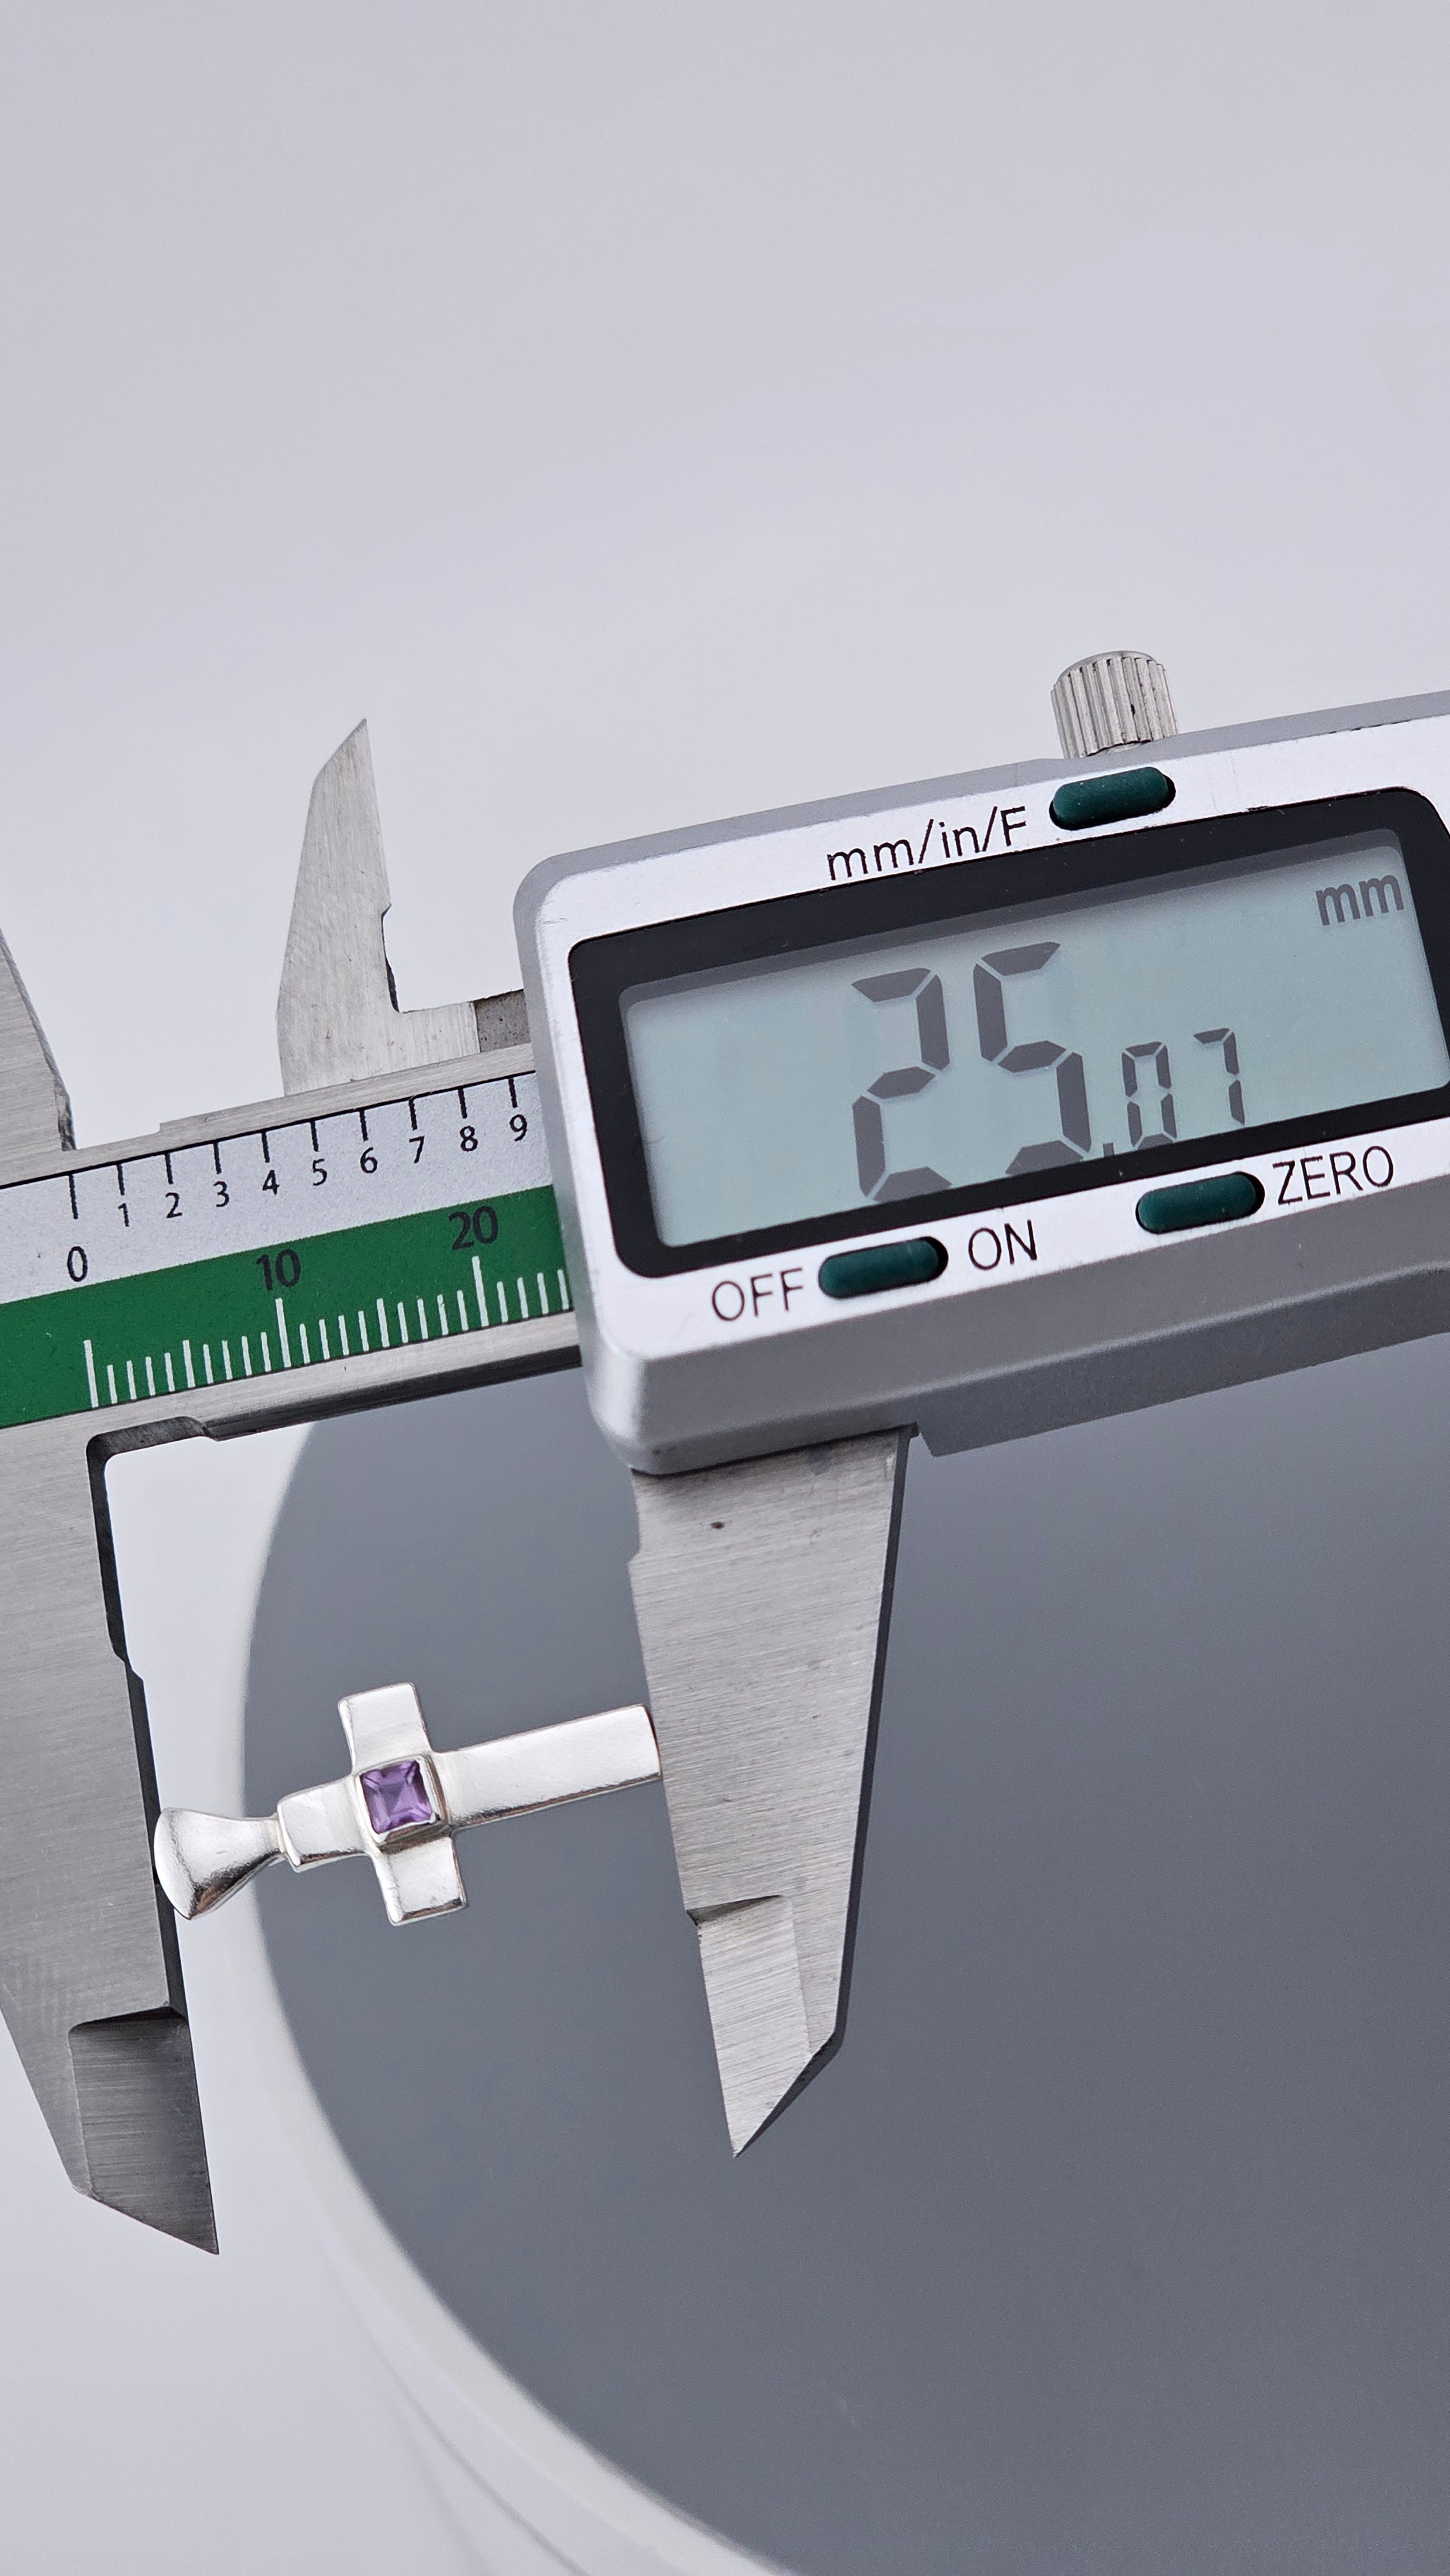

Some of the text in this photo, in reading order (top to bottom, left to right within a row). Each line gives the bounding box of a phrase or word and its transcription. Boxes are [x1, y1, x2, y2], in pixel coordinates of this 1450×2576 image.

[827, 806, 1027, 881] mm/in/F
[1315, 873, 1405, 926] mm
[851, 941, 1245, 1203] 25.07
[118, 1113, 528, 1227] 1 2 3 4 5 6 7 8 9
[1272, 1145, 1395, 1206] ZERO
[67, 1245, 88, 1282] 0
[257, 1206, 499, 1291] 10 20
[968, 1220, 1038, 1271] ON
[711, 1267, 805, 1321] OFF
